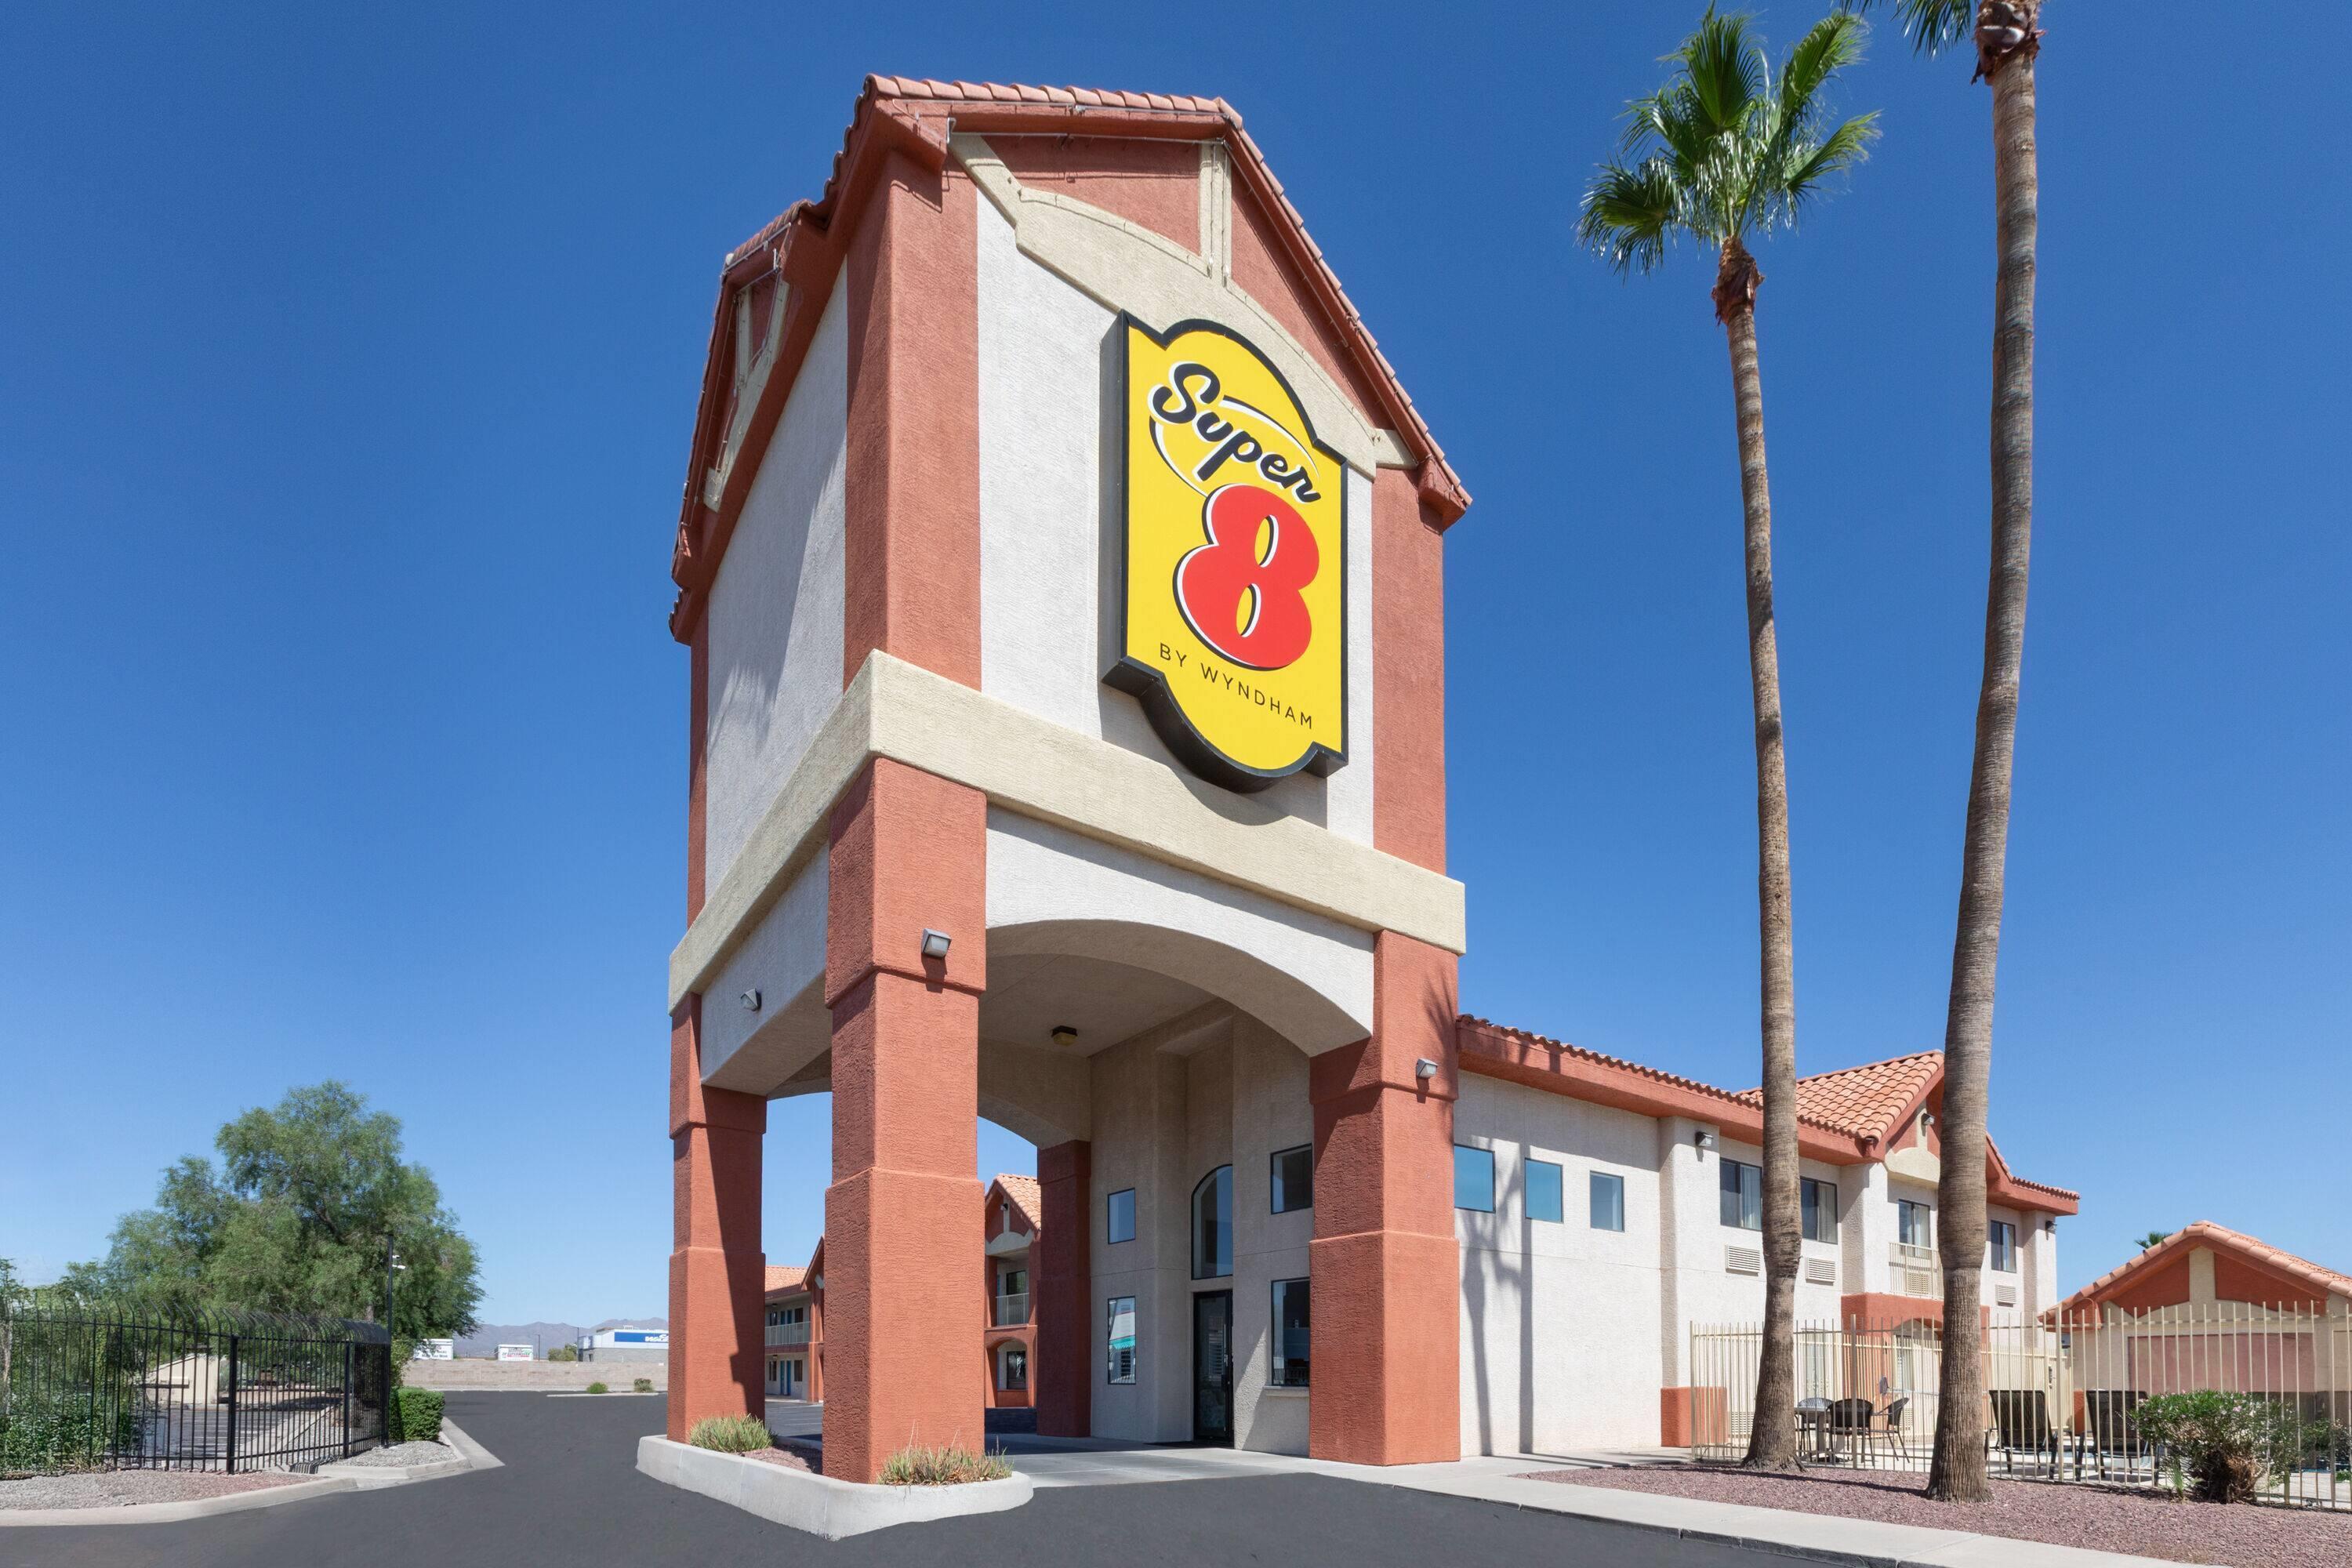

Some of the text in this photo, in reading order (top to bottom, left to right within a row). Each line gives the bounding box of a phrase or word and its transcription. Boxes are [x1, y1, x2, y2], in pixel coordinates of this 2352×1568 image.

[1148, 361, 1321, 503] Super
[1173, 484, 1319, 670] 8
[1160, 642, 1312, 730] BY WYNDHAM
